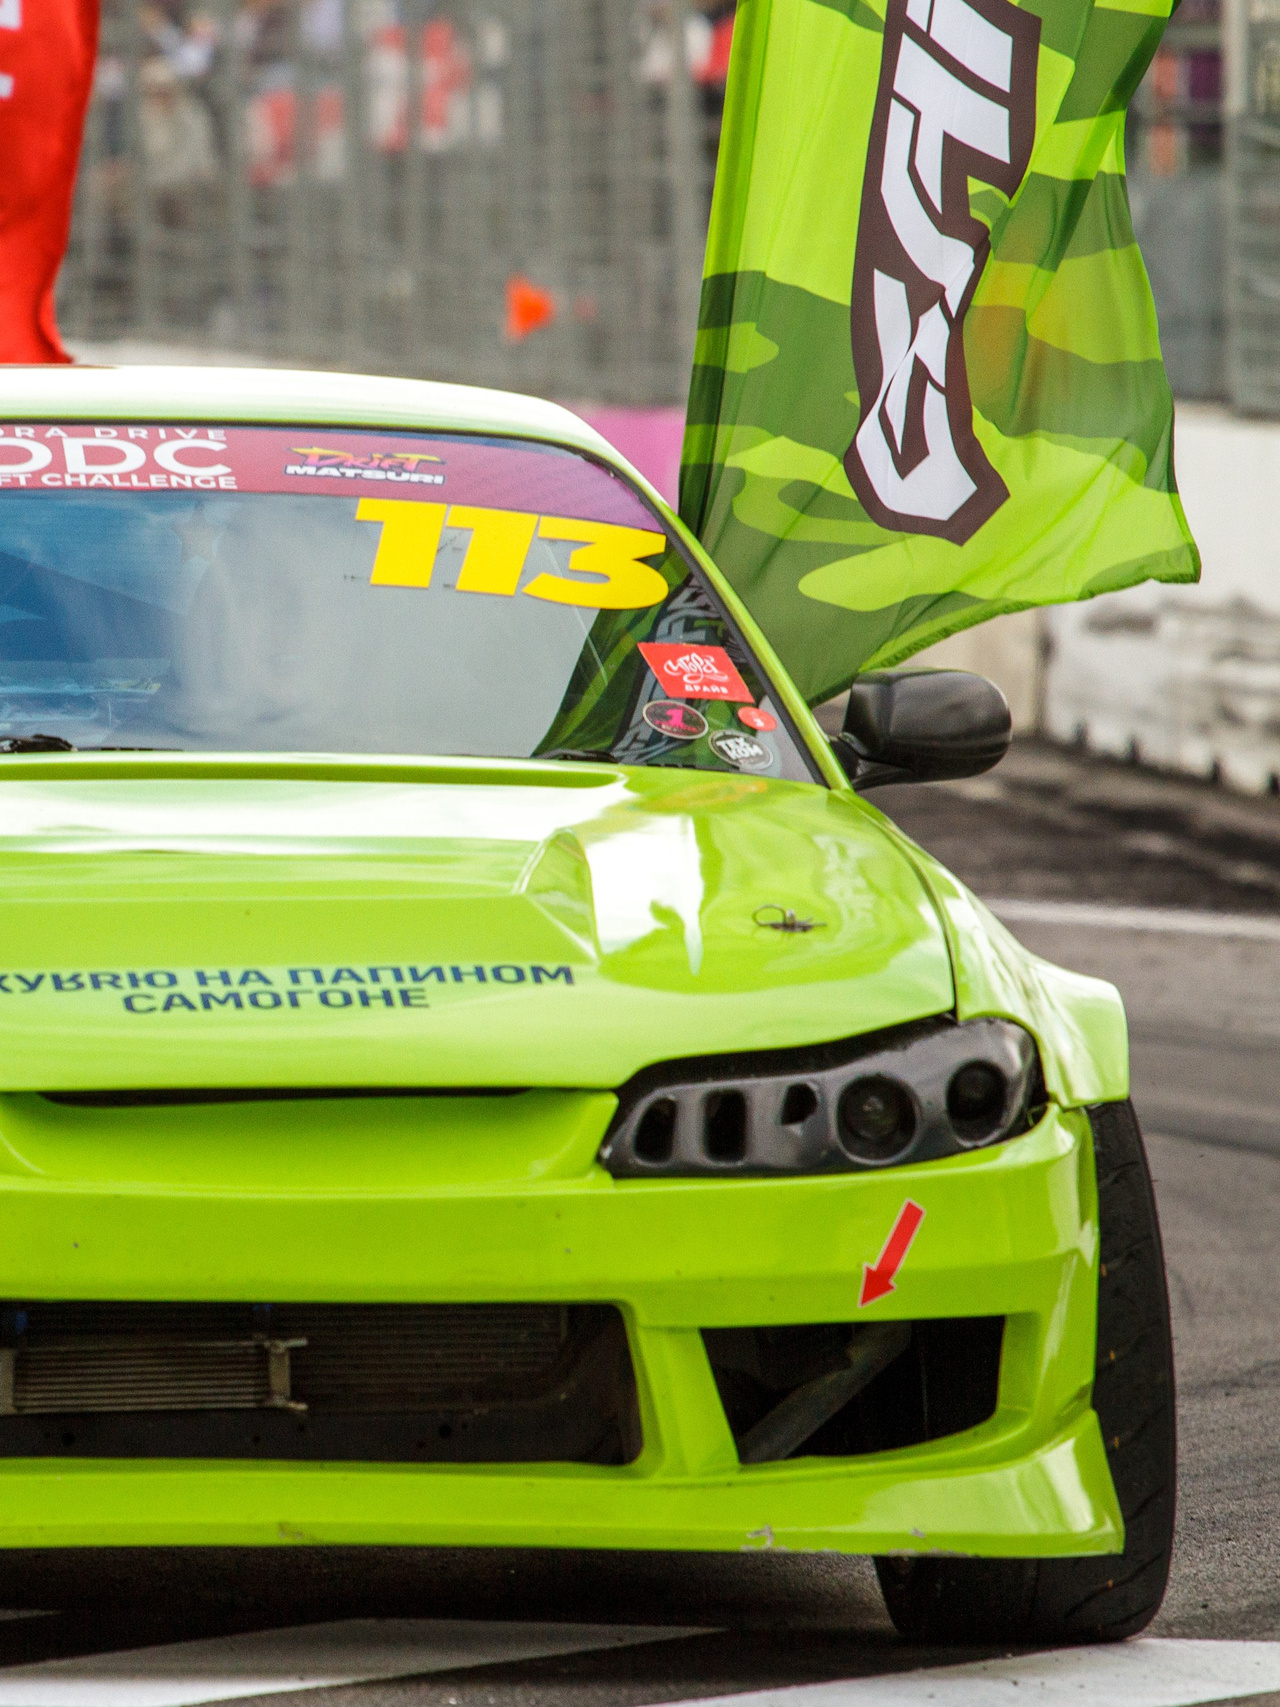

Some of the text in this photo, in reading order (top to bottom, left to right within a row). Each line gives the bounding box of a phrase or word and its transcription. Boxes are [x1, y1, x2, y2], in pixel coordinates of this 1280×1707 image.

[94, 427, 227, 441] DRIVE
[41, 473, 238, 489] CHALLENGE
[285, 465, 445, 485] MATSURI
[355, 497, 669, 610] 113
[194, 969, 274, 988] НА
[287, 964, 575, 986] ПАПИНОМ
[122, 987, 431, 1014] САМОГОНЕ
